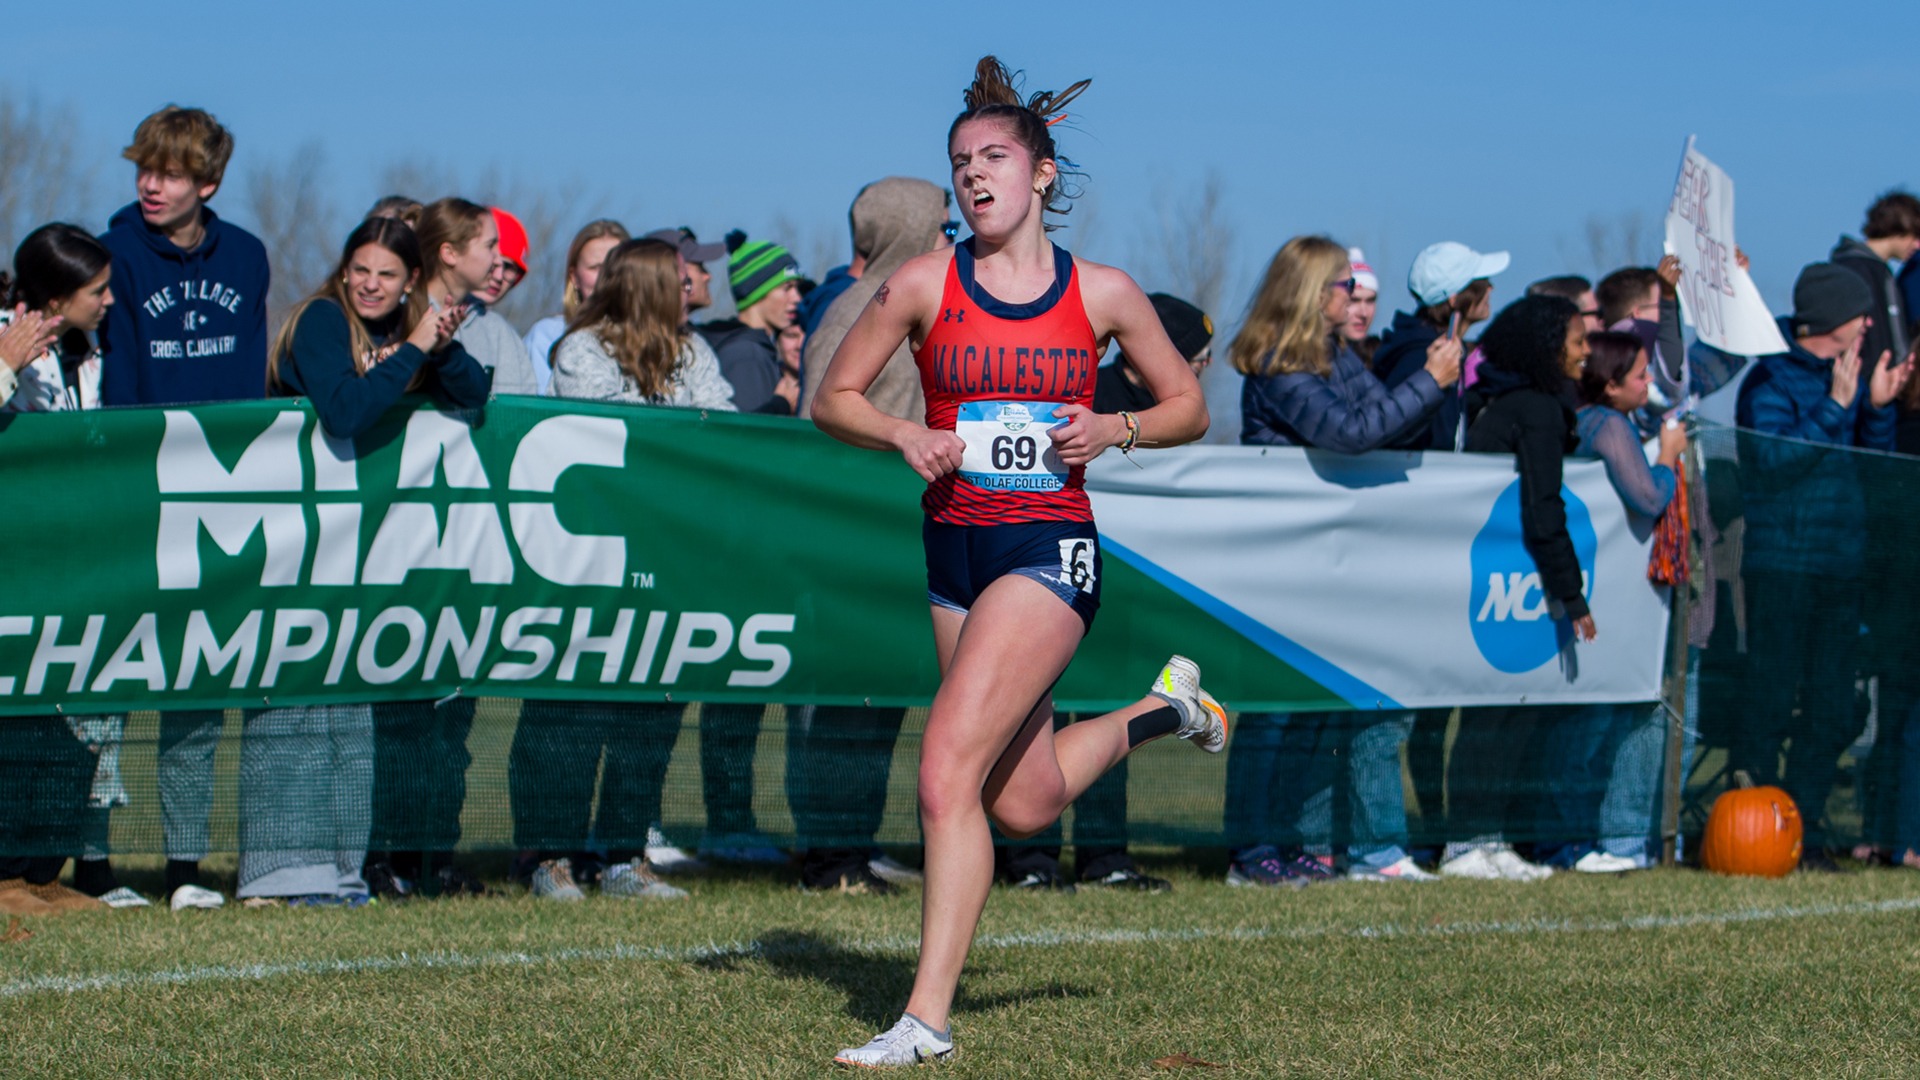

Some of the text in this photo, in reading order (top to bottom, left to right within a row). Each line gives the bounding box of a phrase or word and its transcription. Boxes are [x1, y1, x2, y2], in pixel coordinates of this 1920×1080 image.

[143, 286, 176, 318] THE
[150, 340, 183, 358] CROSS
[933, 344, 1088, 397] MACALESTER
[991, 435, 1036, 471] 69
[156, 410, 628, 590] MIAC
[967, 475, 1060, 489] ST. OLAF COLLEGE
[631, 572, 655, 588] TM
[1071, 541, 1089, 590] 6
[1476, 569, 1589, 622] NC
